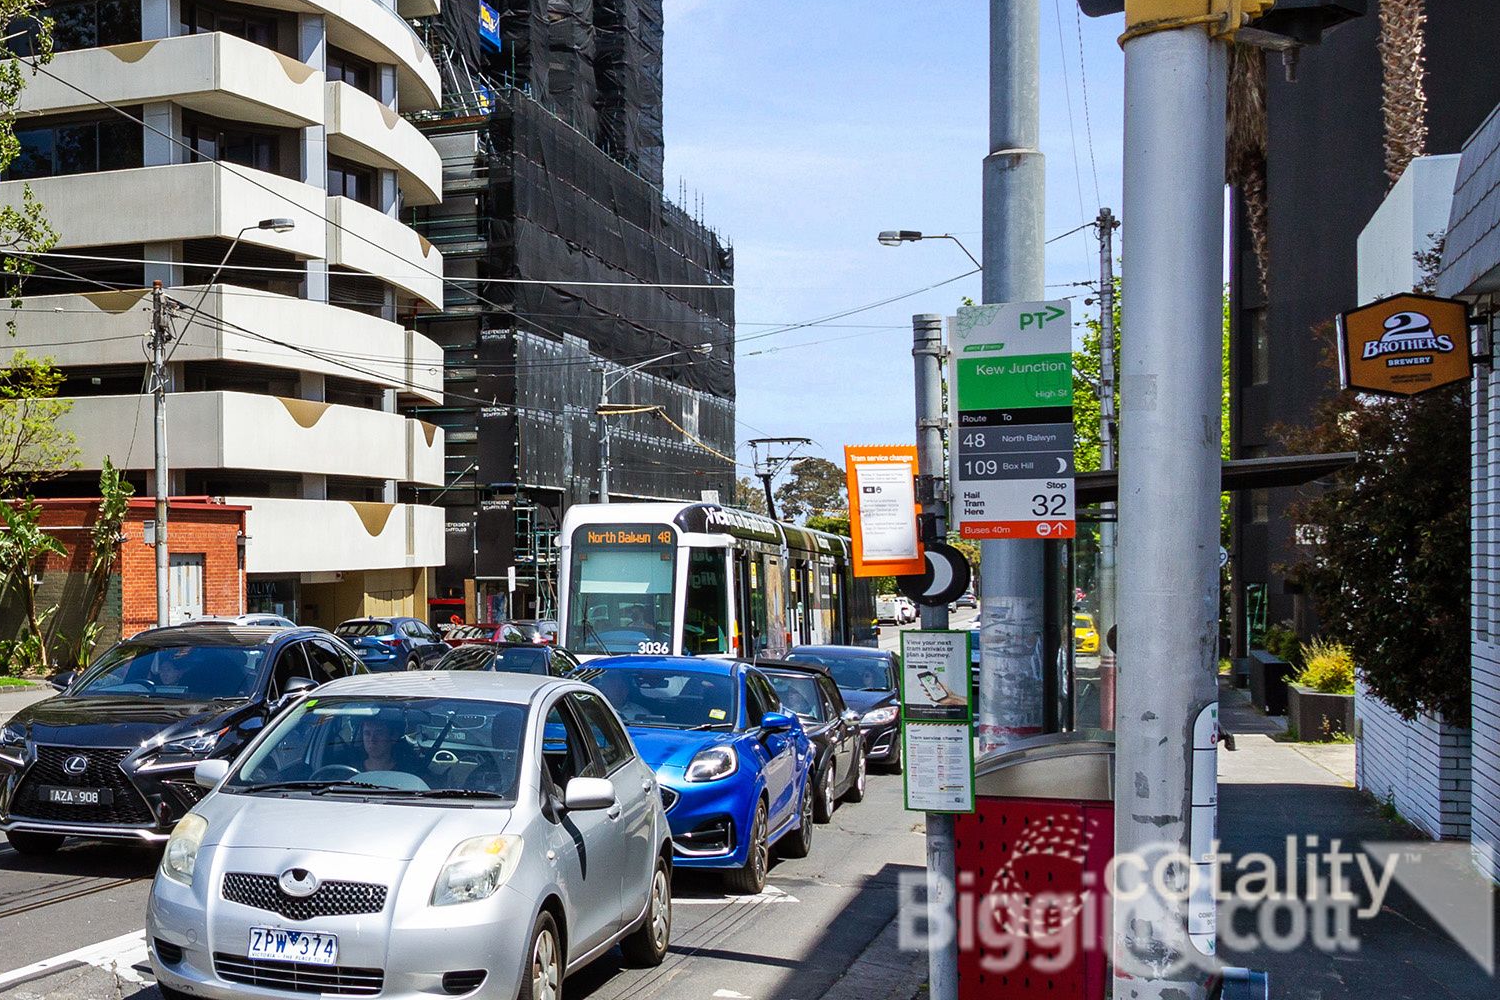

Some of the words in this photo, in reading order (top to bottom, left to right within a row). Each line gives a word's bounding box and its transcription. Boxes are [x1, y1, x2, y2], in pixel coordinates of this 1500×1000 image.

[1382, 312, 1435, 342] 2
[1362, 334, 1454, 359] BROTHERS
[1387, 356, 1431, 367] BREWERY
[976, 364, 1005, 376] Kew
[1008, 361, 1067, 375] Junction
[1035, 390, 1056, 399] High
[1057, 389, 1068, 397] St
[962, 415, 987, 423] Route
[1001, 413, 1012, 421] To
[962, 433, 986, 448] 48
[1002, 435, 1025, 443] North
[1026, 433, 1057, 443] Balwyn
[850, 454, 866, 462] Tram
[867, 454, 888, 462] service
[889, 454, 914, 463] changes
[964, 460, 998, 476] 109
[1002, 462, 1019, 470] Box
[1045, 481, 1068, 490] Stop
[964, 499, 986, 507] Tram
[1031, 493, 1068, 517] 32
[964, 526, 991, 534] Buses
[992, 526, 1011, 534] 40m
[588, 531, 617, 544] North
[618, 531, 651, 544] Balwyn
[657, 531, 671, 544] 48
[637, 641, 669, 654] 3036
[252, 931, 288, 954] ZPW
[299, 936, 334, 958] 374
